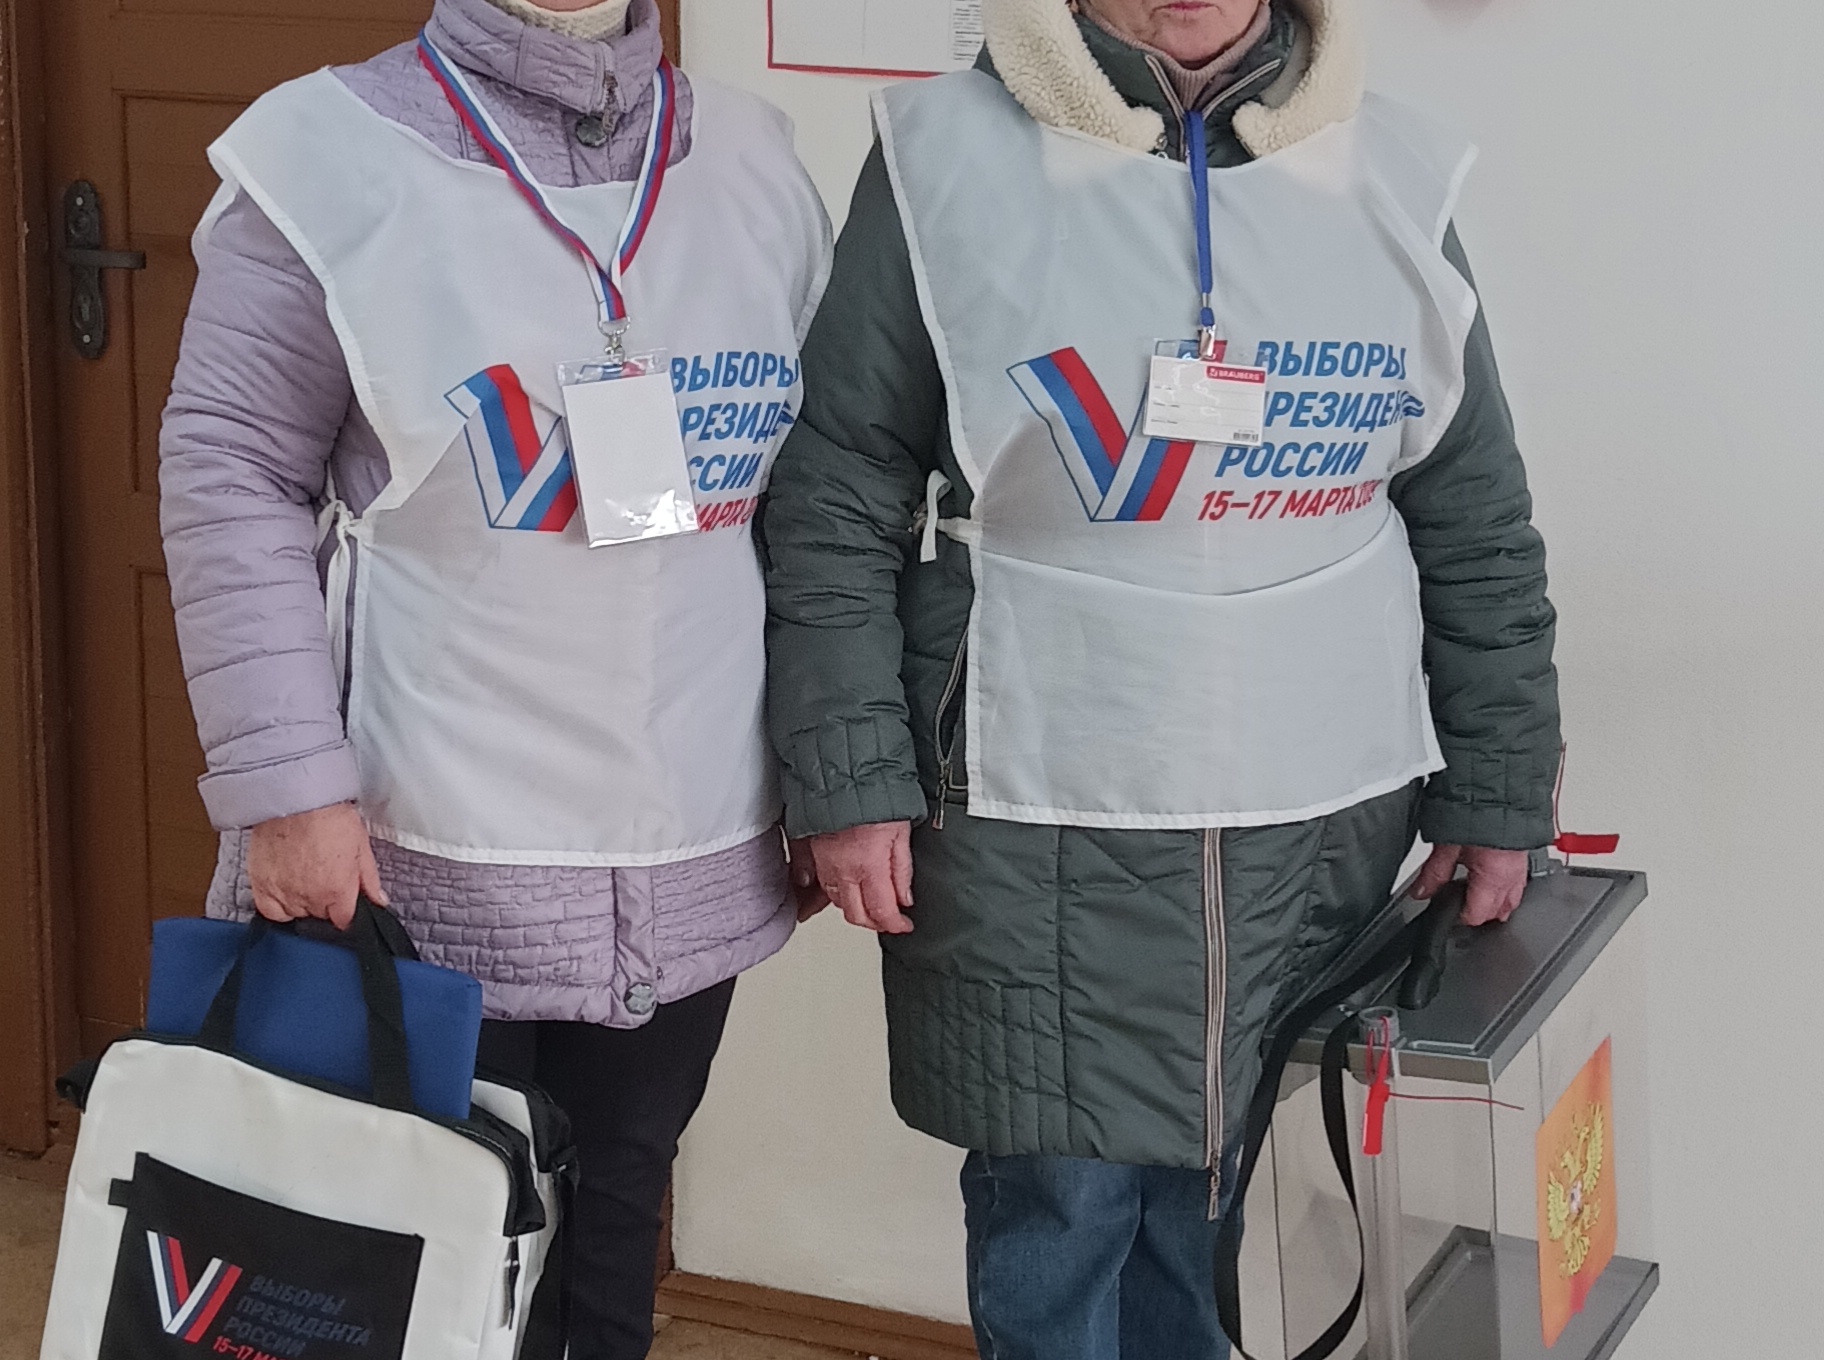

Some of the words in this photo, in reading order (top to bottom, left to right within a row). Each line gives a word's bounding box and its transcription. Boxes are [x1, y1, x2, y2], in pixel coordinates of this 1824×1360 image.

[671, 351, 799, 393] ВЫБОРЫ
[1254, 340, 1407, 380] ВЫБОРЫ
[1214, 441, 1369, 478] РОССИИ
[1279, 484, 1357, 519] МАРТА
[250, 1274, 346, 1316] ВЫБОРЫ
[223, 1316, 307, 1357] РОССИИ
[236, 1296, 372, 1346] ПРЕЗИДЕНТА
